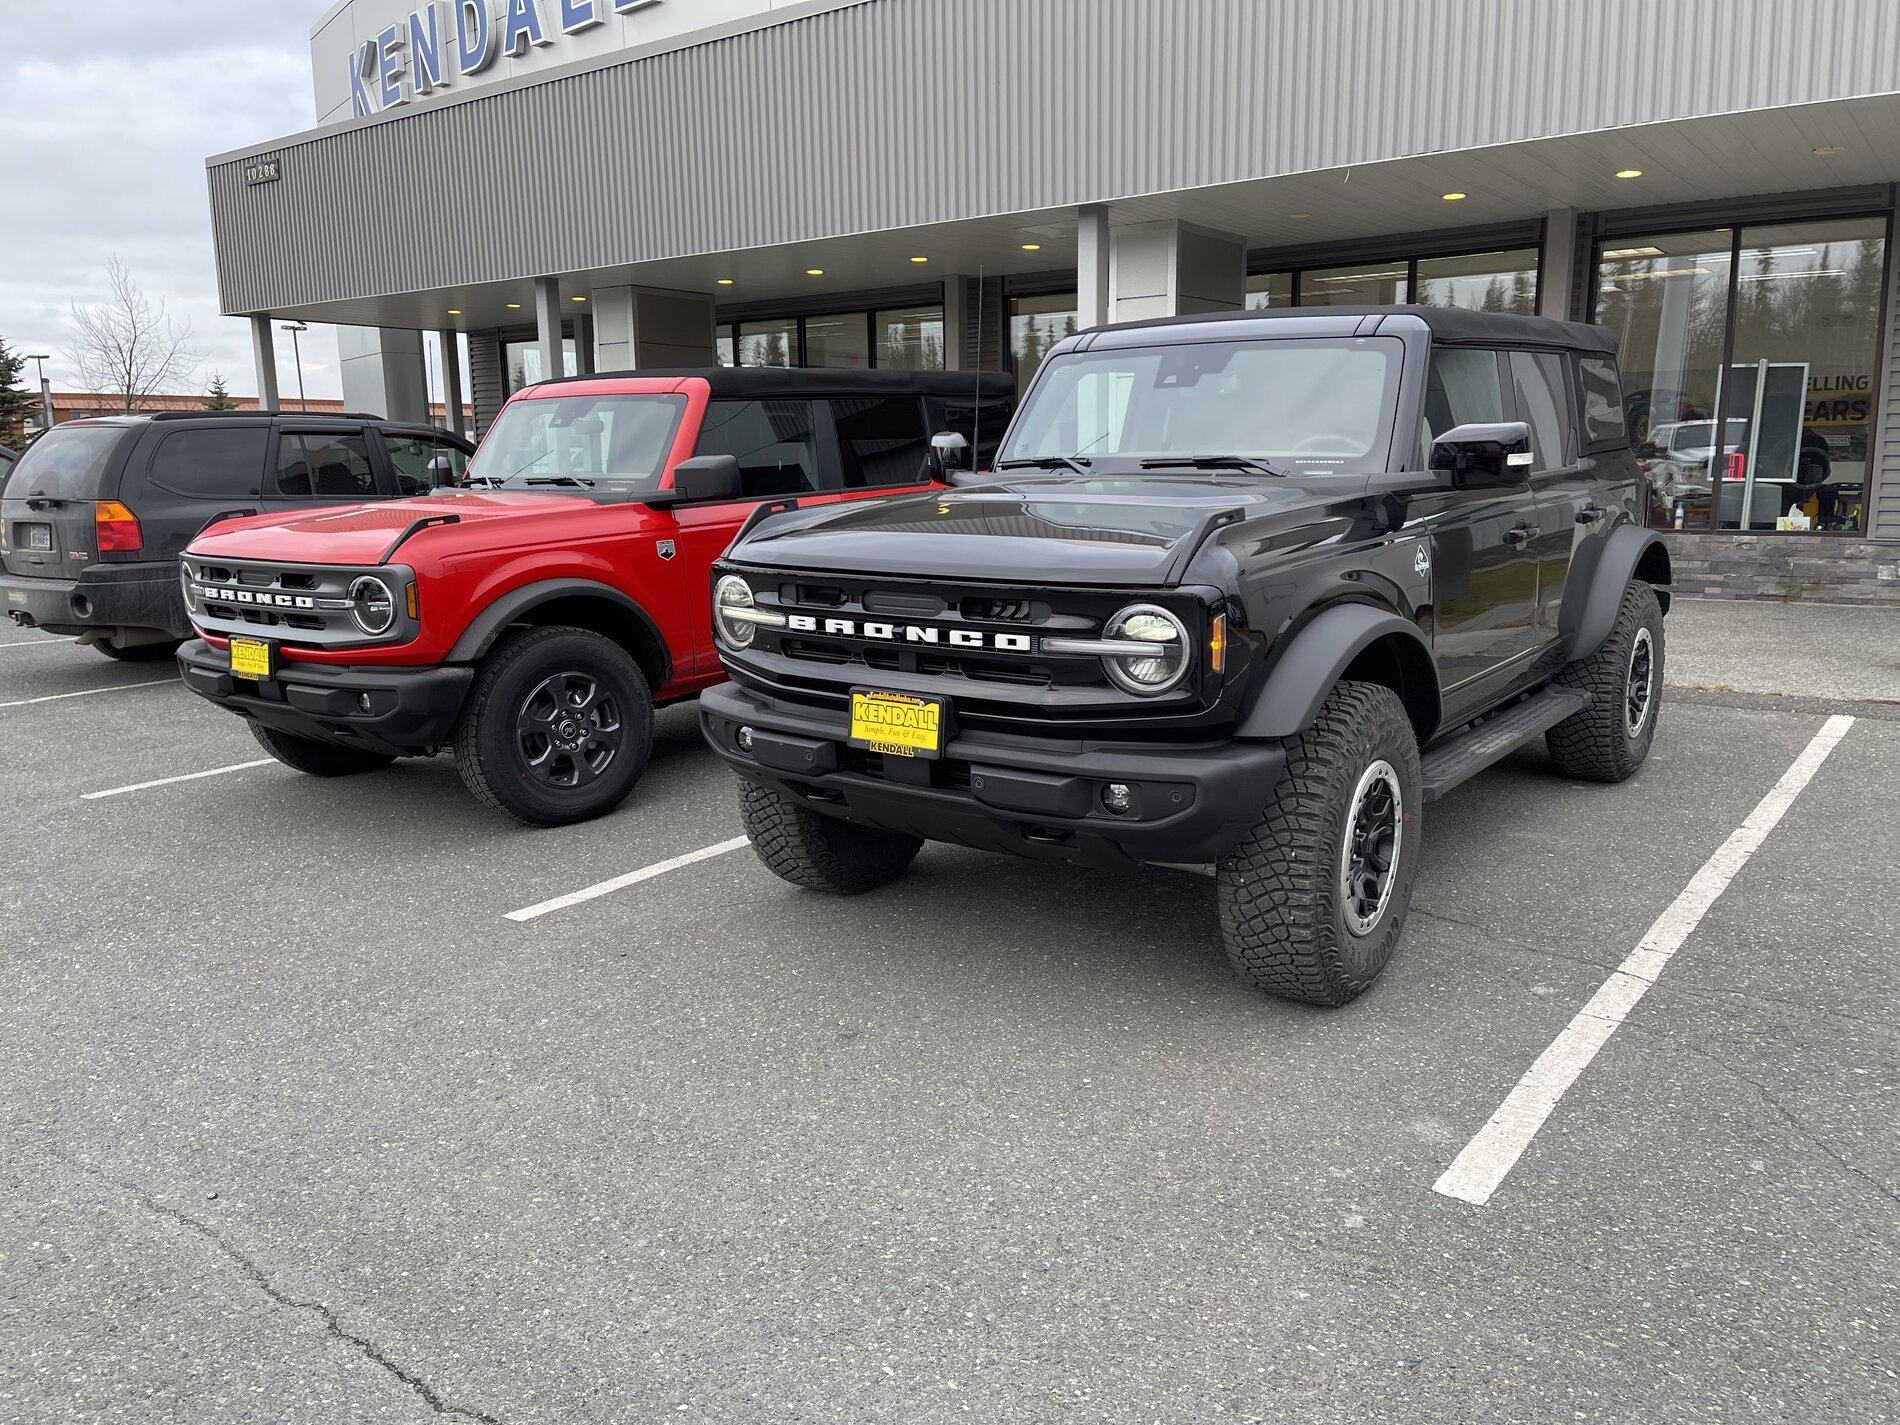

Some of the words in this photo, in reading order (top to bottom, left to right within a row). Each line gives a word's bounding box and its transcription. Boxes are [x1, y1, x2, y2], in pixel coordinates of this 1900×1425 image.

[348, 0, 664, 118] KENDA
[246, 163, 276, 181] 10288
[204, 587, 314, 608] BRONCO
[788, 614, 1031, 651] BRONCO
[854, 702, 938, 731] KENDALL
[869, 740, 915, 757] KENDALL
